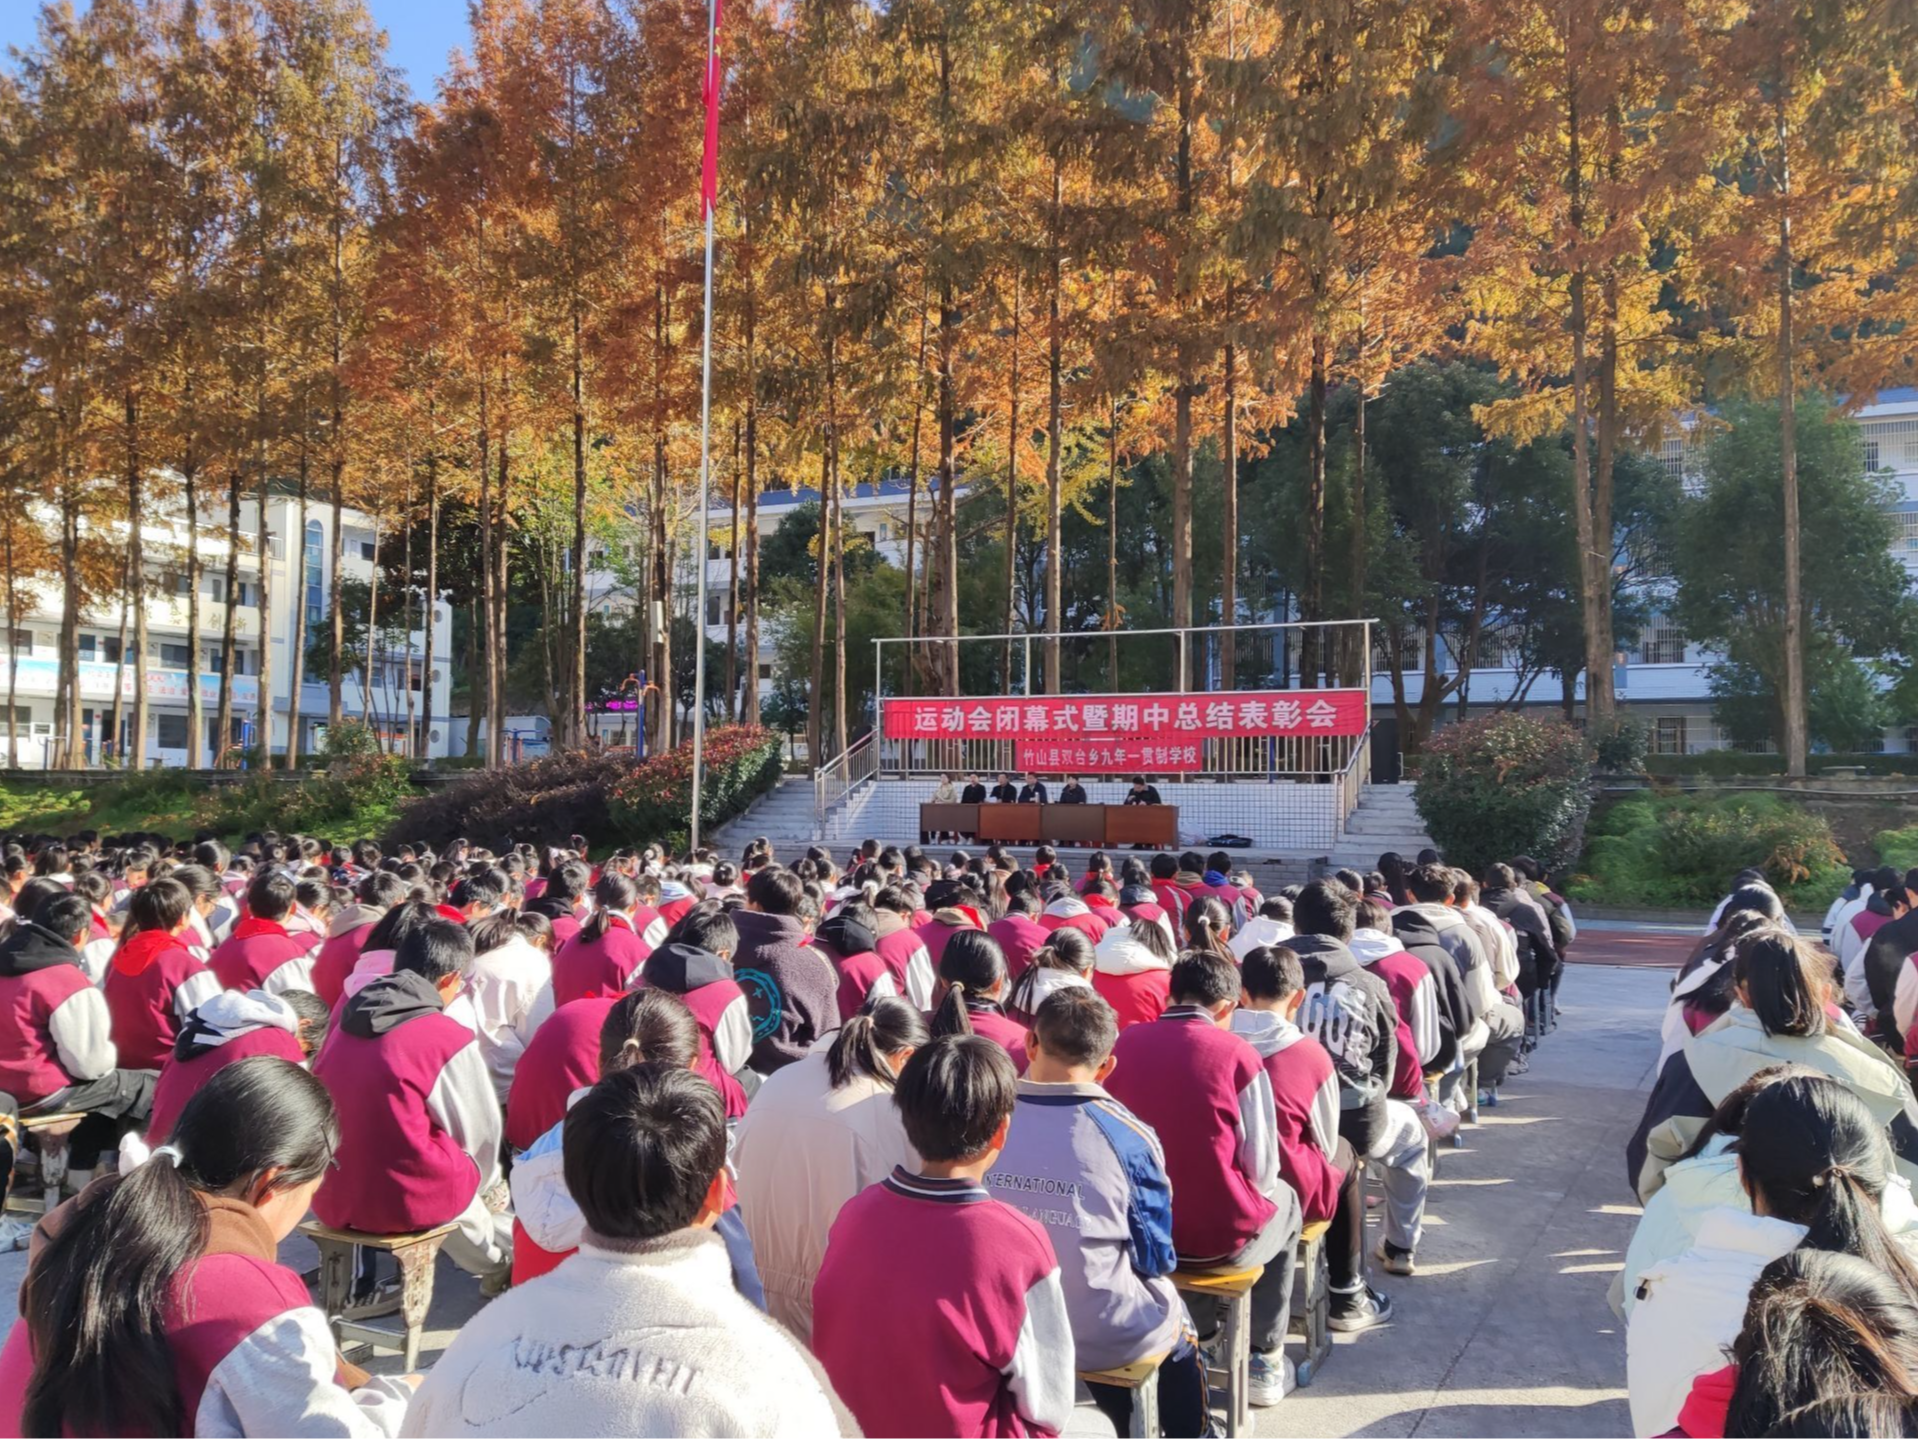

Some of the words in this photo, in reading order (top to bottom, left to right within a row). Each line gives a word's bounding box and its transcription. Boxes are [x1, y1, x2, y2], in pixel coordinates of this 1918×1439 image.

[914, 699, 1338, 732] 运动会闭幕式暨期中总结表彰会
[1023, 745, 1197, 766] 竹山县双台乡九年一贯制学校
[985, 1172, 1086, 1201] NTERNATIONAL
